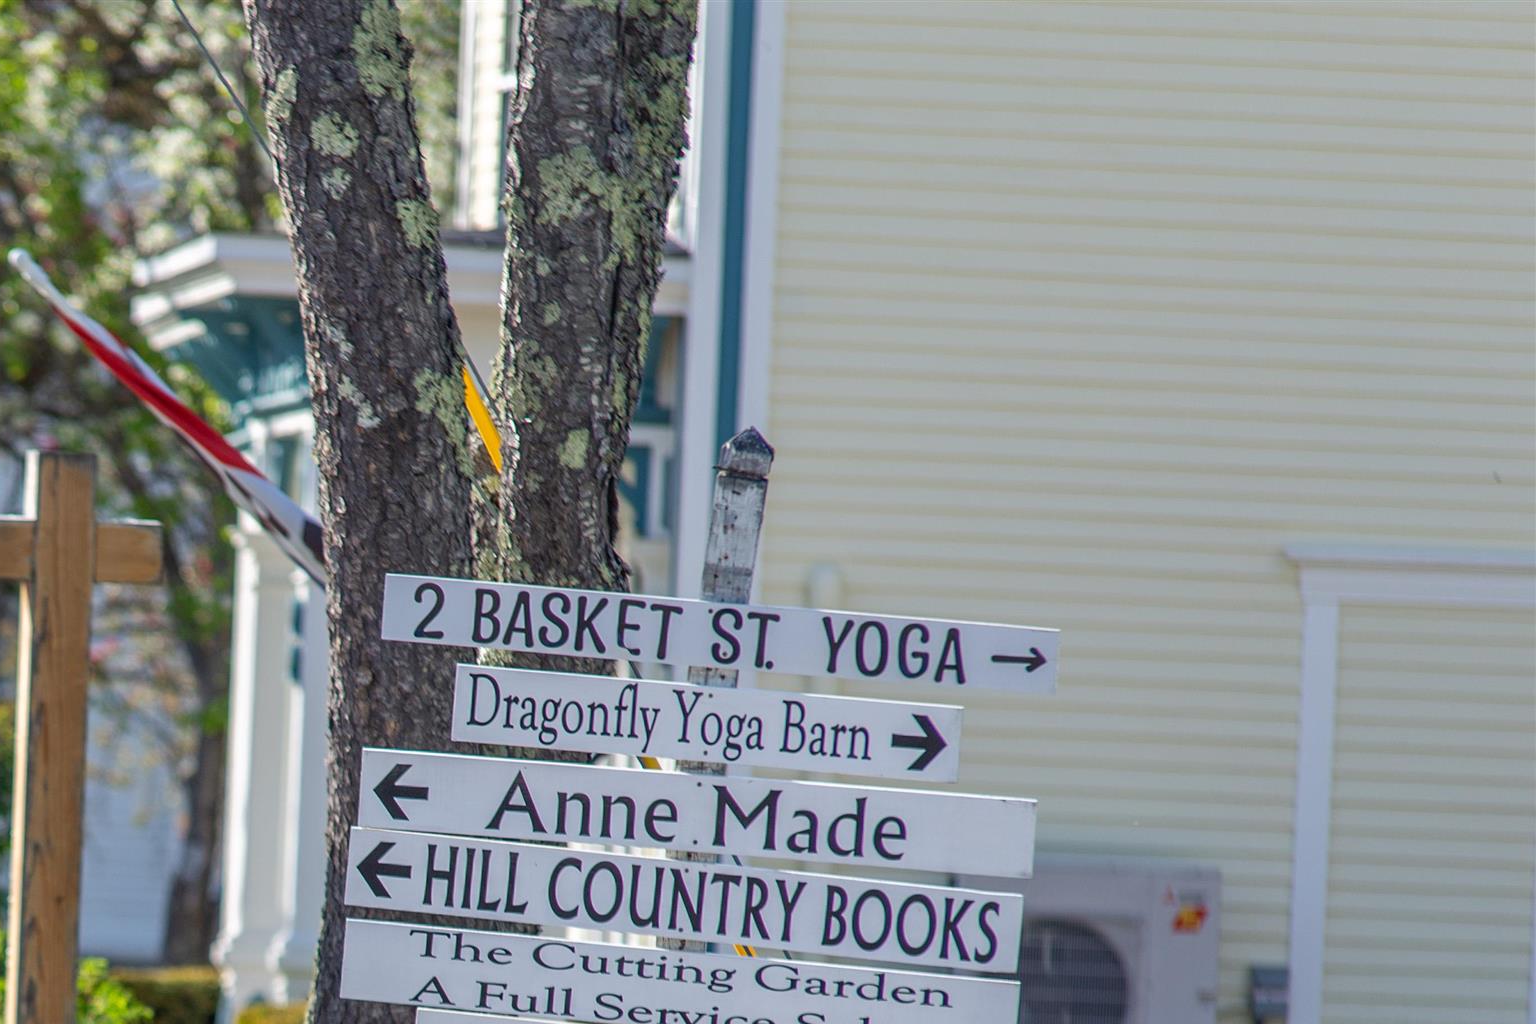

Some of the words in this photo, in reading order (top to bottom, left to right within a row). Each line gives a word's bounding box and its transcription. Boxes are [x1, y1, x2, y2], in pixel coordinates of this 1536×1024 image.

[414, 582, 444, 640] 2
[472, 588, 684, 661] BASKET
[710, 608, 782, 670] ST.
[822, 616, 967, 685] YOGA
[465, 670, 661, 754] Dragonfly
[671, 689, 765, 762] Yoga
[780, 699, 873, 761] Barn
[485, 769, 679, 844] Anne
[710, 783, 908, 862] Made
[421, 843, 530, 916] HILL
[546, 856, 808, 944] COUNTRY
[822, 890, 1001, 966] BOOKS
[408, 929, 513, 967] The
[531, 942, 738, 994] Cutting
[753, 963, 954, 1010] Garden
[409, 976, 456, 1005] A
[473, 981, 575, 1019] Full
